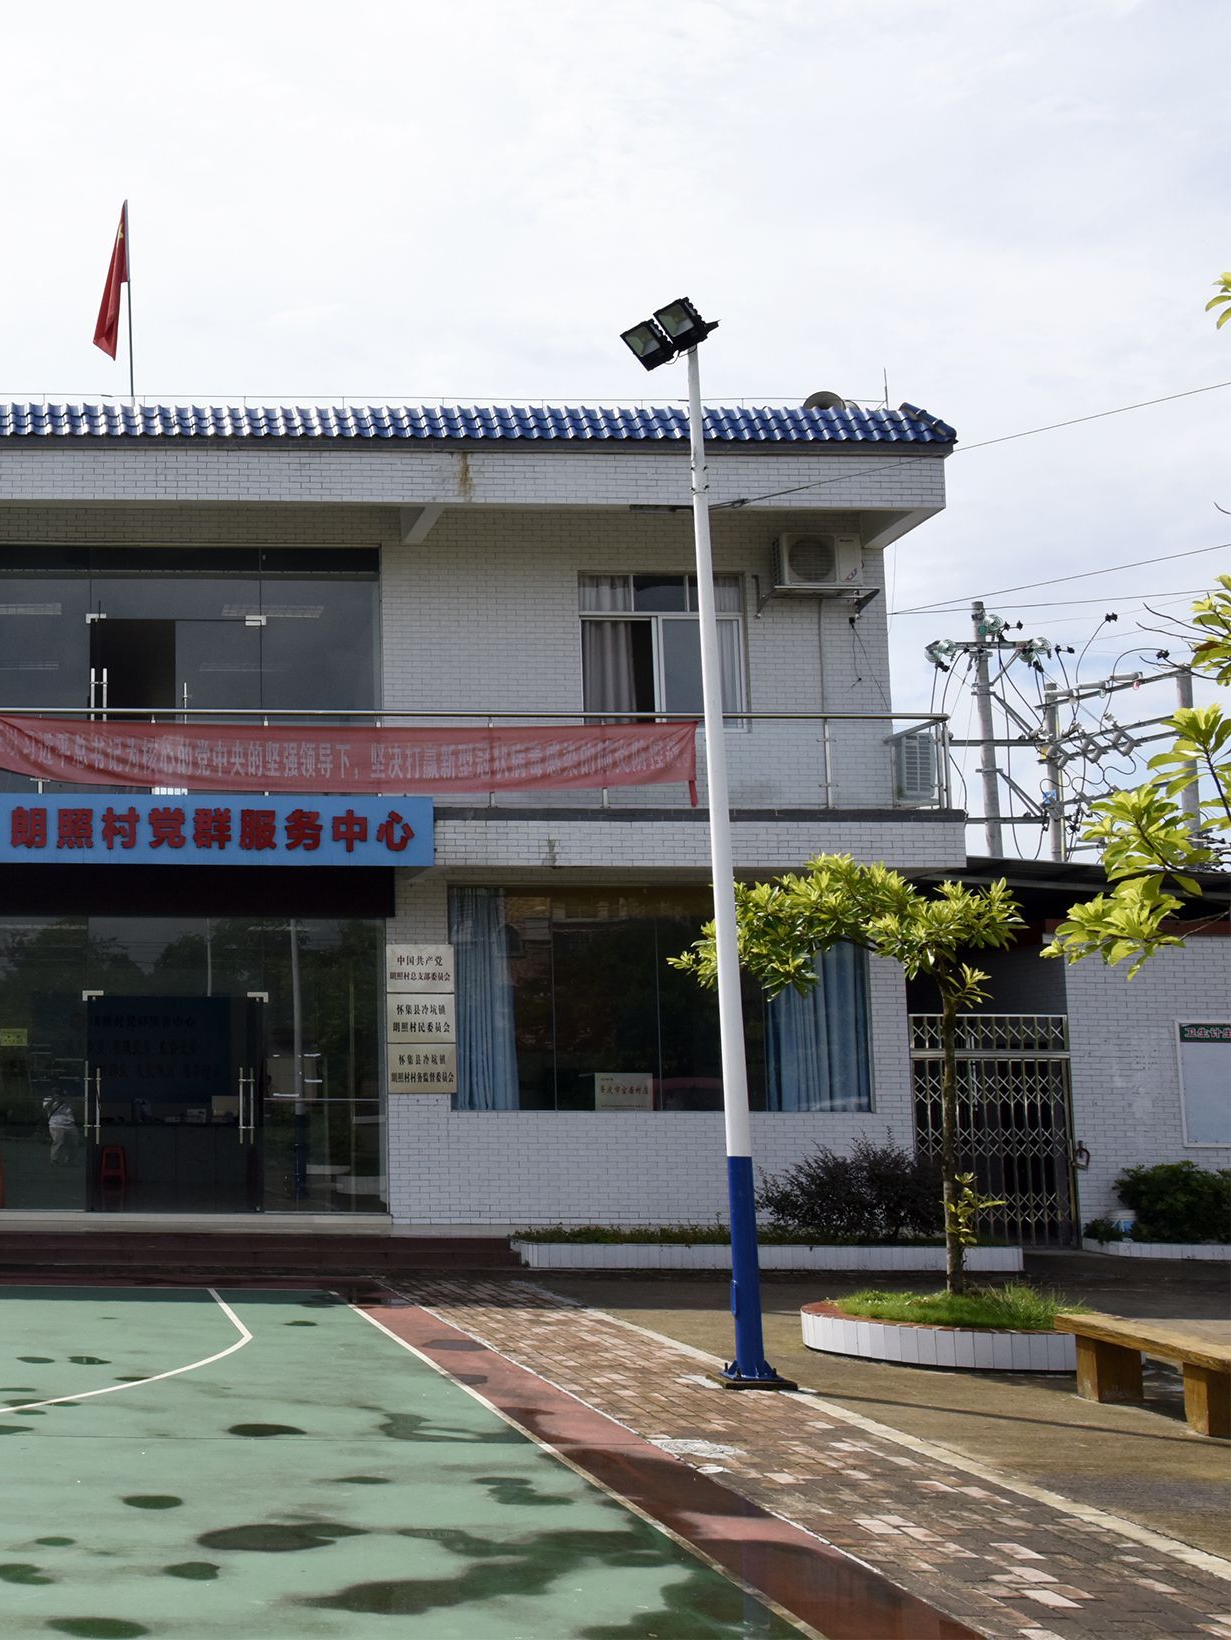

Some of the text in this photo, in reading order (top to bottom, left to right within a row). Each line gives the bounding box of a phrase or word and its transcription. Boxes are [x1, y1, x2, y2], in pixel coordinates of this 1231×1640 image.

[11, 807, 415, 852] 朗照村党群服务中心
[397, 955, 443, 966] 中国共产党
[389, 971, 451, 982] 朗照村总支部委员会
[396, 1004, 446, 1016] 怀集县冷坑镇
[392, 1021, 451, 1033] 朗照村民委员会
[398, 1054, 446, 1066] 怀集县冷坑镇
[391, 1072, 454, 1083] 朗照村村务监督委员会
